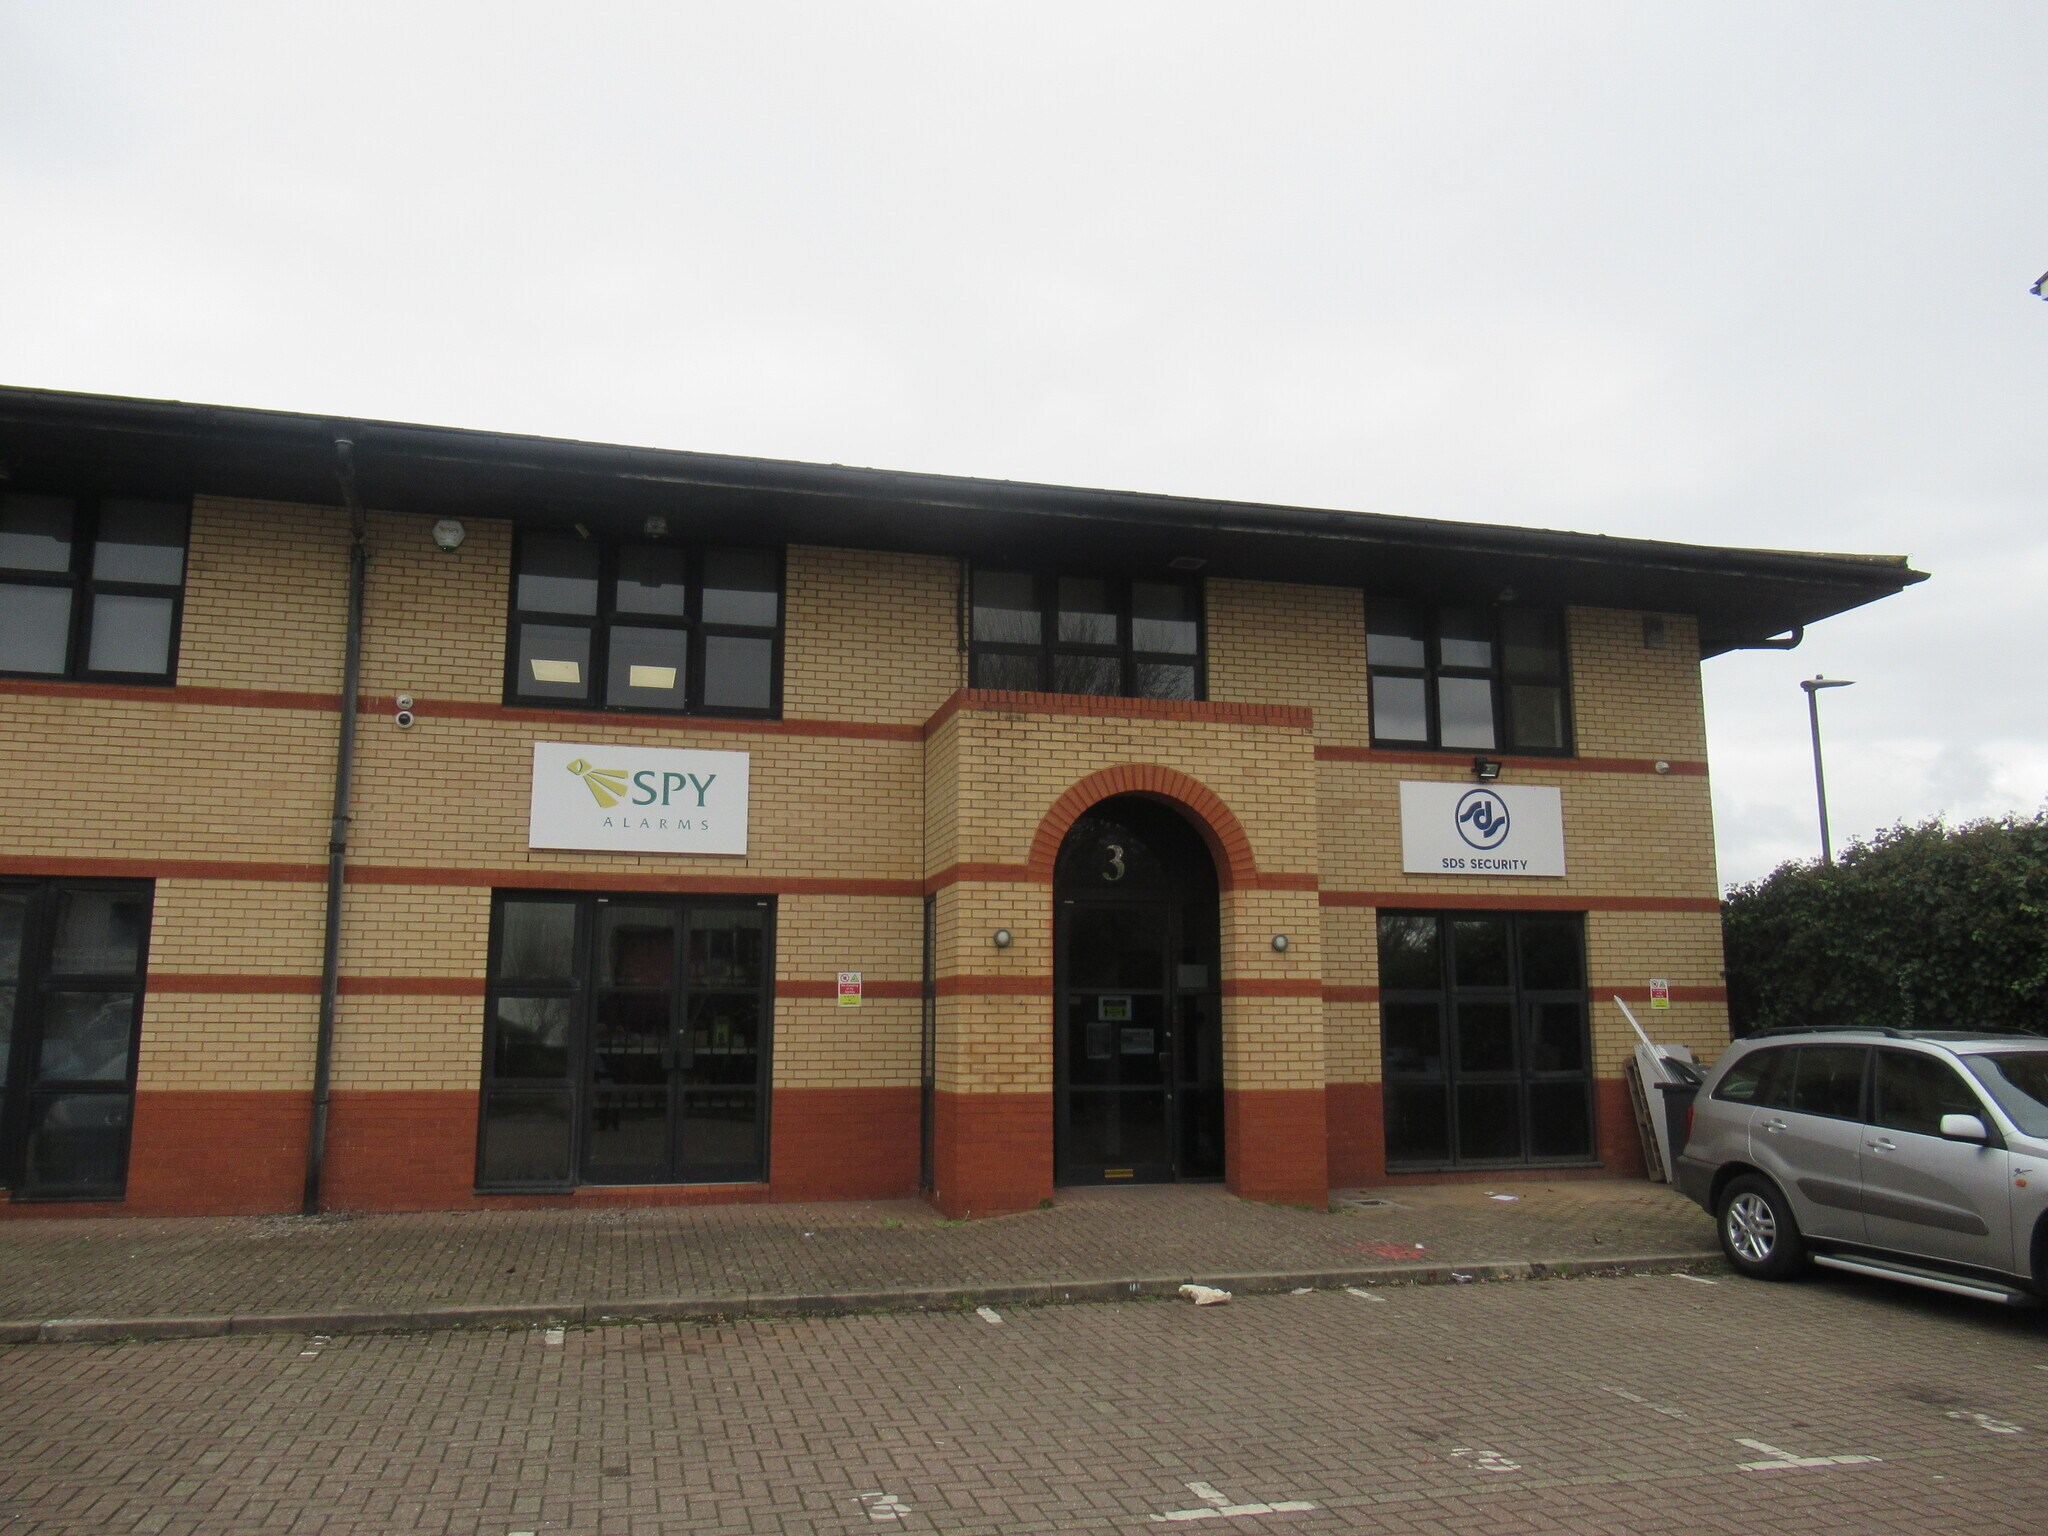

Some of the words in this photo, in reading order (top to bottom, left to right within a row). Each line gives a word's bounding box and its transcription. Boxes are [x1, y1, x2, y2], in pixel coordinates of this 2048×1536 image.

[632, 770, 717, 807] SPY
[603, 816, 709, 831] ALARMS
[1102, 844, 1126, 882] 3
[1442, 857, 1465, 869] SDS
[1470, 858, 1528, 870] SECURITY
